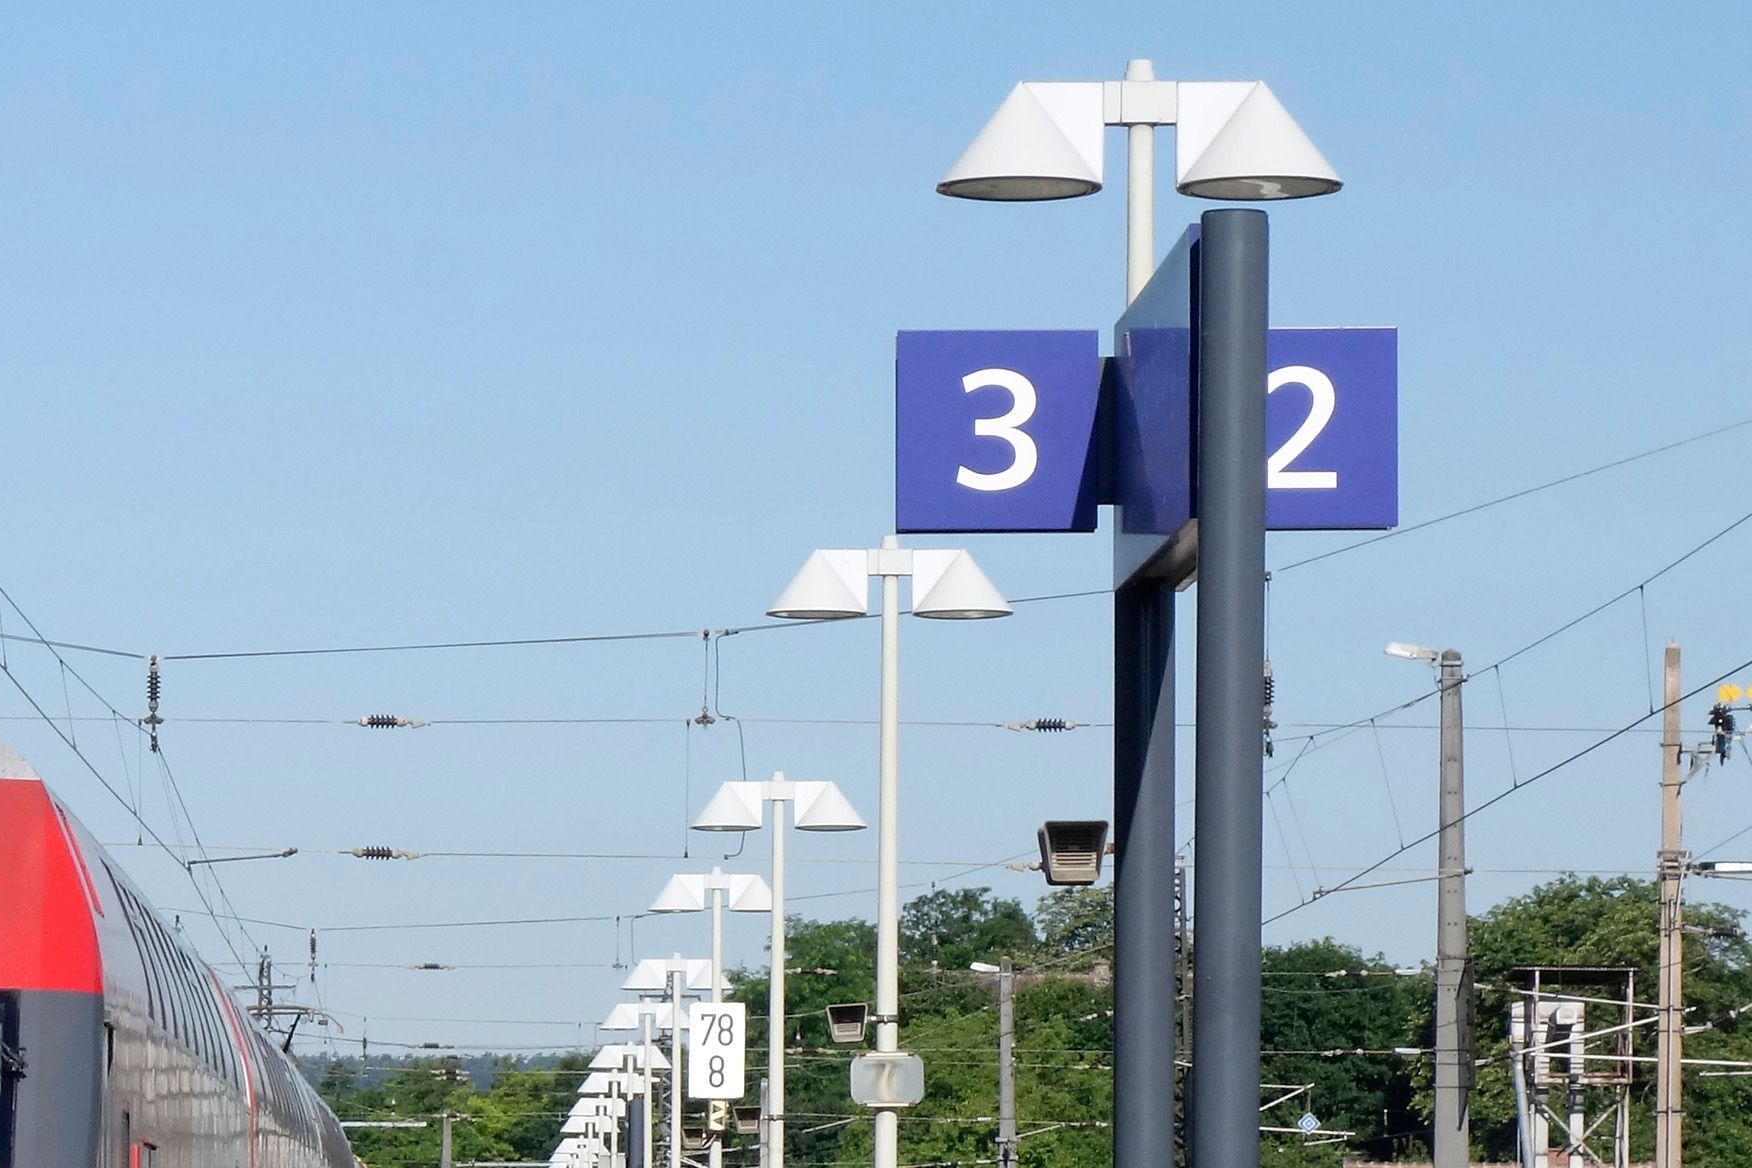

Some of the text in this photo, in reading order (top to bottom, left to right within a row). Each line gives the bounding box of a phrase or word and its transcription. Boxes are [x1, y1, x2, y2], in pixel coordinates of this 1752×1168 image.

[956, 368, 1039, 492] 3
[1267, 365, 1338, 489] 2
[700, 1013, 734, 1046] 78
[708, 1055, 725, 1088] 8
